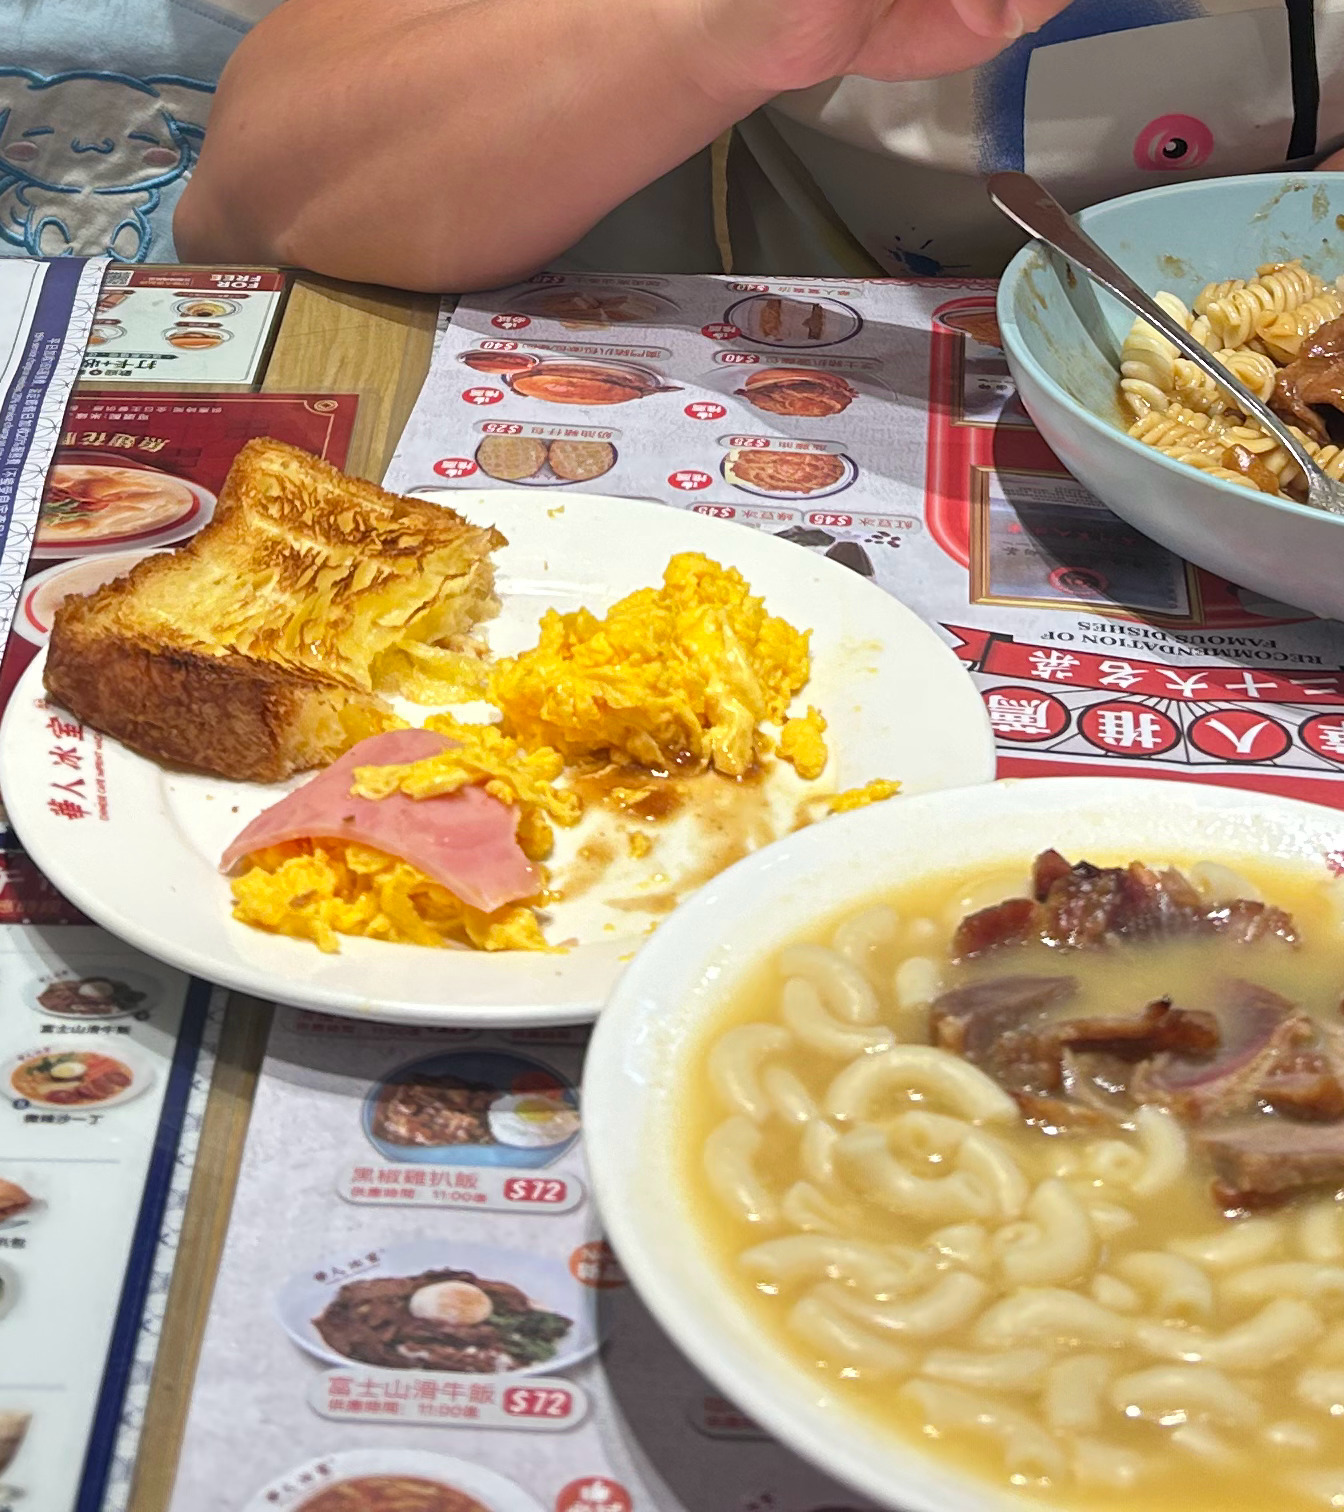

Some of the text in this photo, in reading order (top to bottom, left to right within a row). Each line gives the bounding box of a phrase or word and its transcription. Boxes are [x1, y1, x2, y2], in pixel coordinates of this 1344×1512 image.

[209, 273, 262, 282] FREE
[215, 280, 260, 290] FOR
[482, 340, 516, 351] $40
[724, 353, 757, 363] $40
[485, 422, 520, 435] $25
[733, 437, 767, 448] $25
[810, 513, 914, 529] 紅豆冰 $45
[1076, 620, 1276, 649] FAMOUS DISHES
[1039, 629, 1323, 666] RECOMMENDATION OF
[1028, 649, 1340, 699] 二十大名菜
[45, 716, 93, 821] 華人冰室
[349, 1167, 563, 1203] 黑椒雞扒飯 $72
[327, 1375, 566, 1417] 富士山滑牛飯 $72
